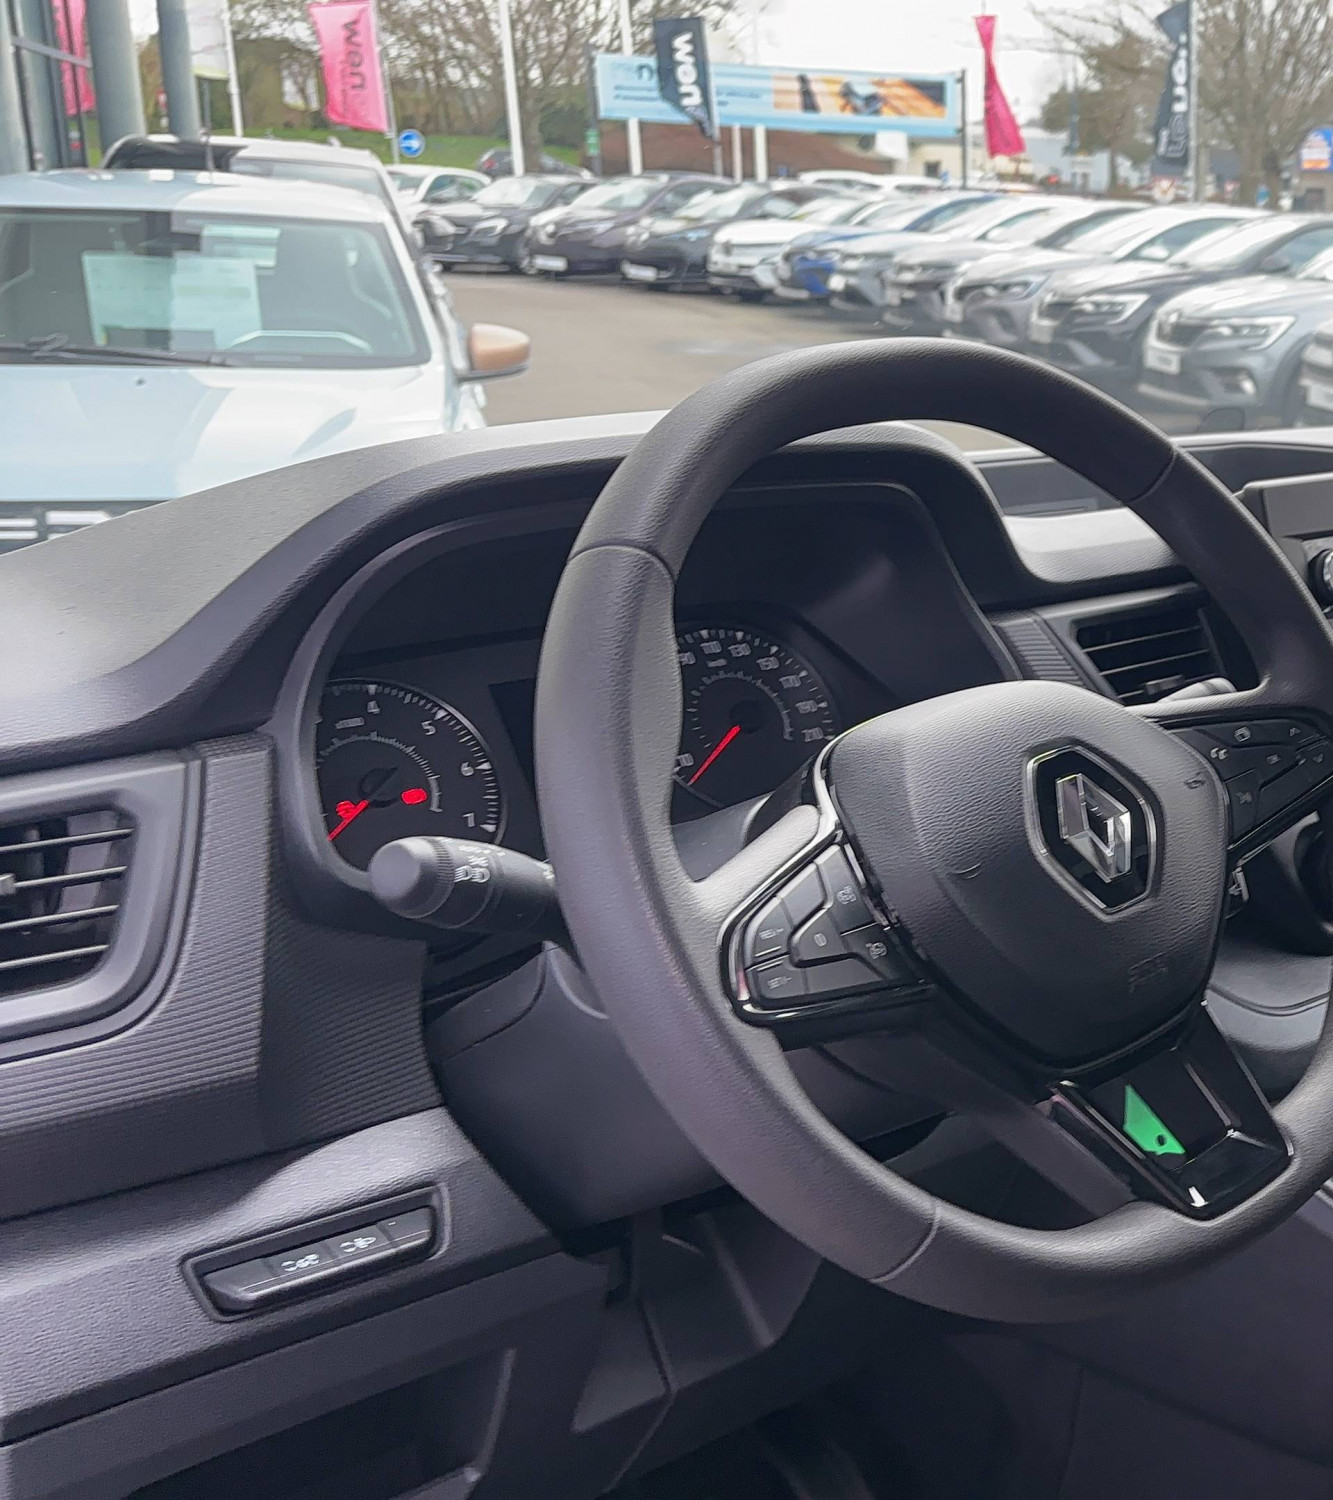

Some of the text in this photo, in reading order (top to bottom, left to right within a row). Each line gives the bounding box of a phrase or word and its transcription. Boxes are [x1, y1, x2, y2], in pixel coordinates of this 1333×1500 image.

[366, 700, 380, 714] 4
[421, 720, 436, 736] 5
[460, 762, 475, 777] 6
[462, 812, 476, 828] 7
